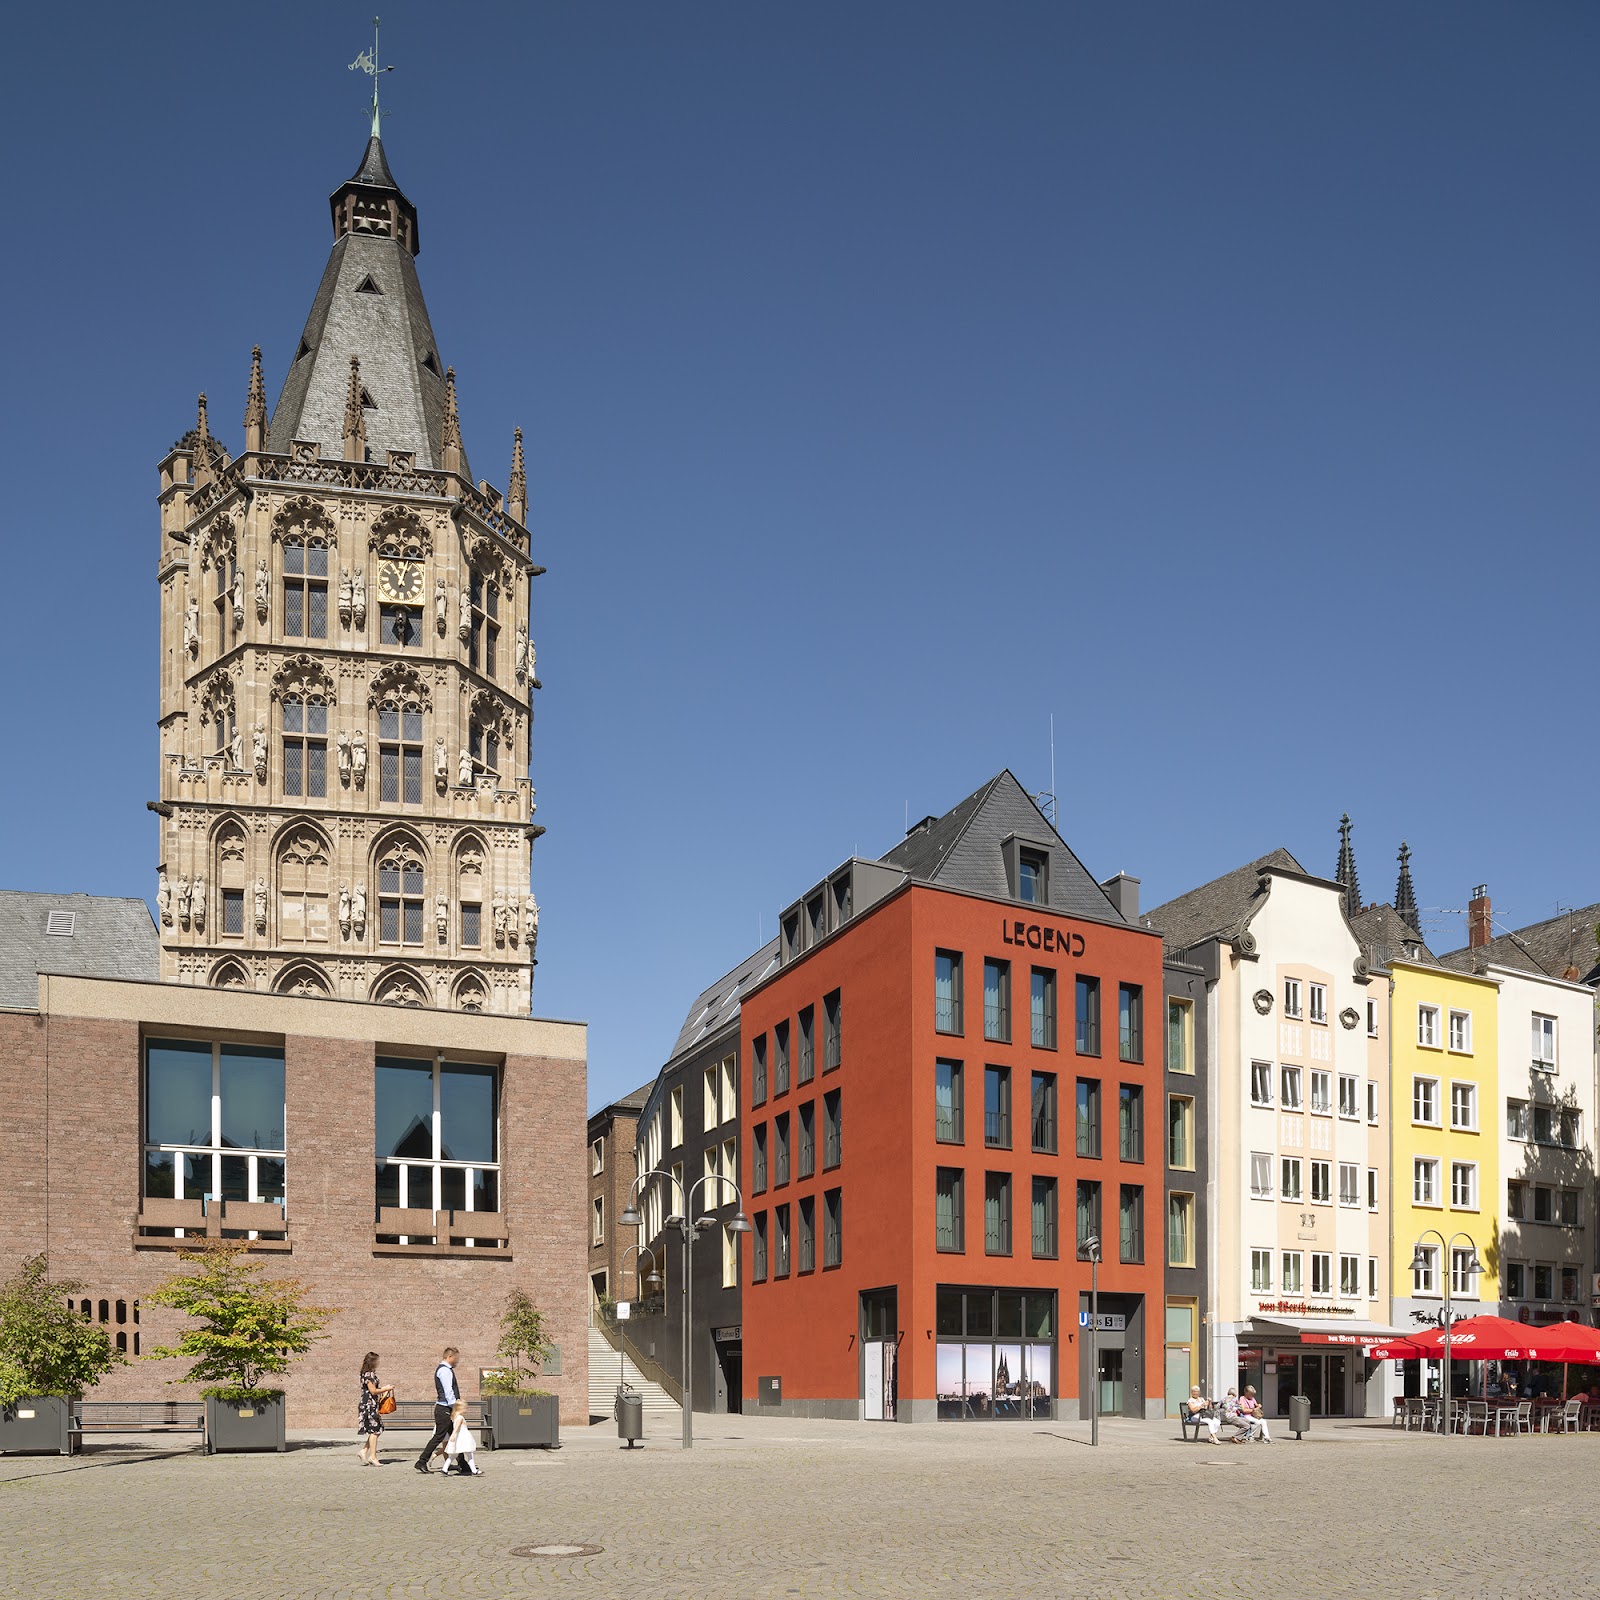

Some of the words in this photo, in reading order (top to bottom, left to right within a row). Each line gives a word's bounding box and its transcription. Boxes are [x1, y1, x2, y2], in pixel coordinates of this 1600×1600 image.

[1003, 919, 1085, 957] LEGEND
[1079, 1313, 1087, 1326] U
[1106, 1317, 1112, 1326] 5
